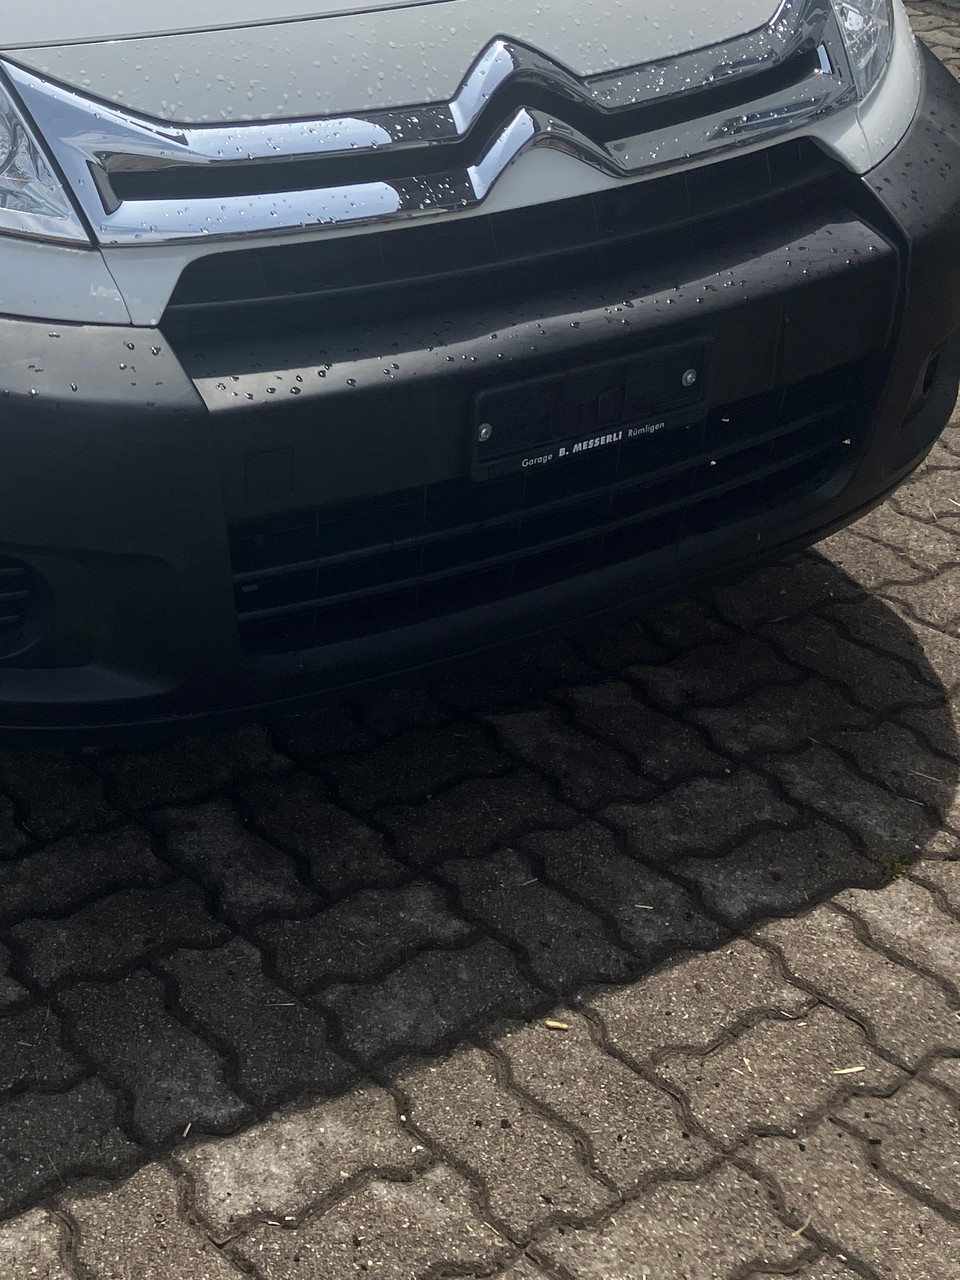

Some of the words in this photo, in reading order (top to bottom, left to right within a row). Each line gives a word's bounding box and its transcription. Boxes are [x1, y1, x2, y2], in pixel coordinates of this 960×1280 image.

[521, 453, 553, 467] Garage
[558, 447, 569, 457] B.
[572, 431, 622, 453] MESSERLI
[627, 421, 665, 437] Rümligen
